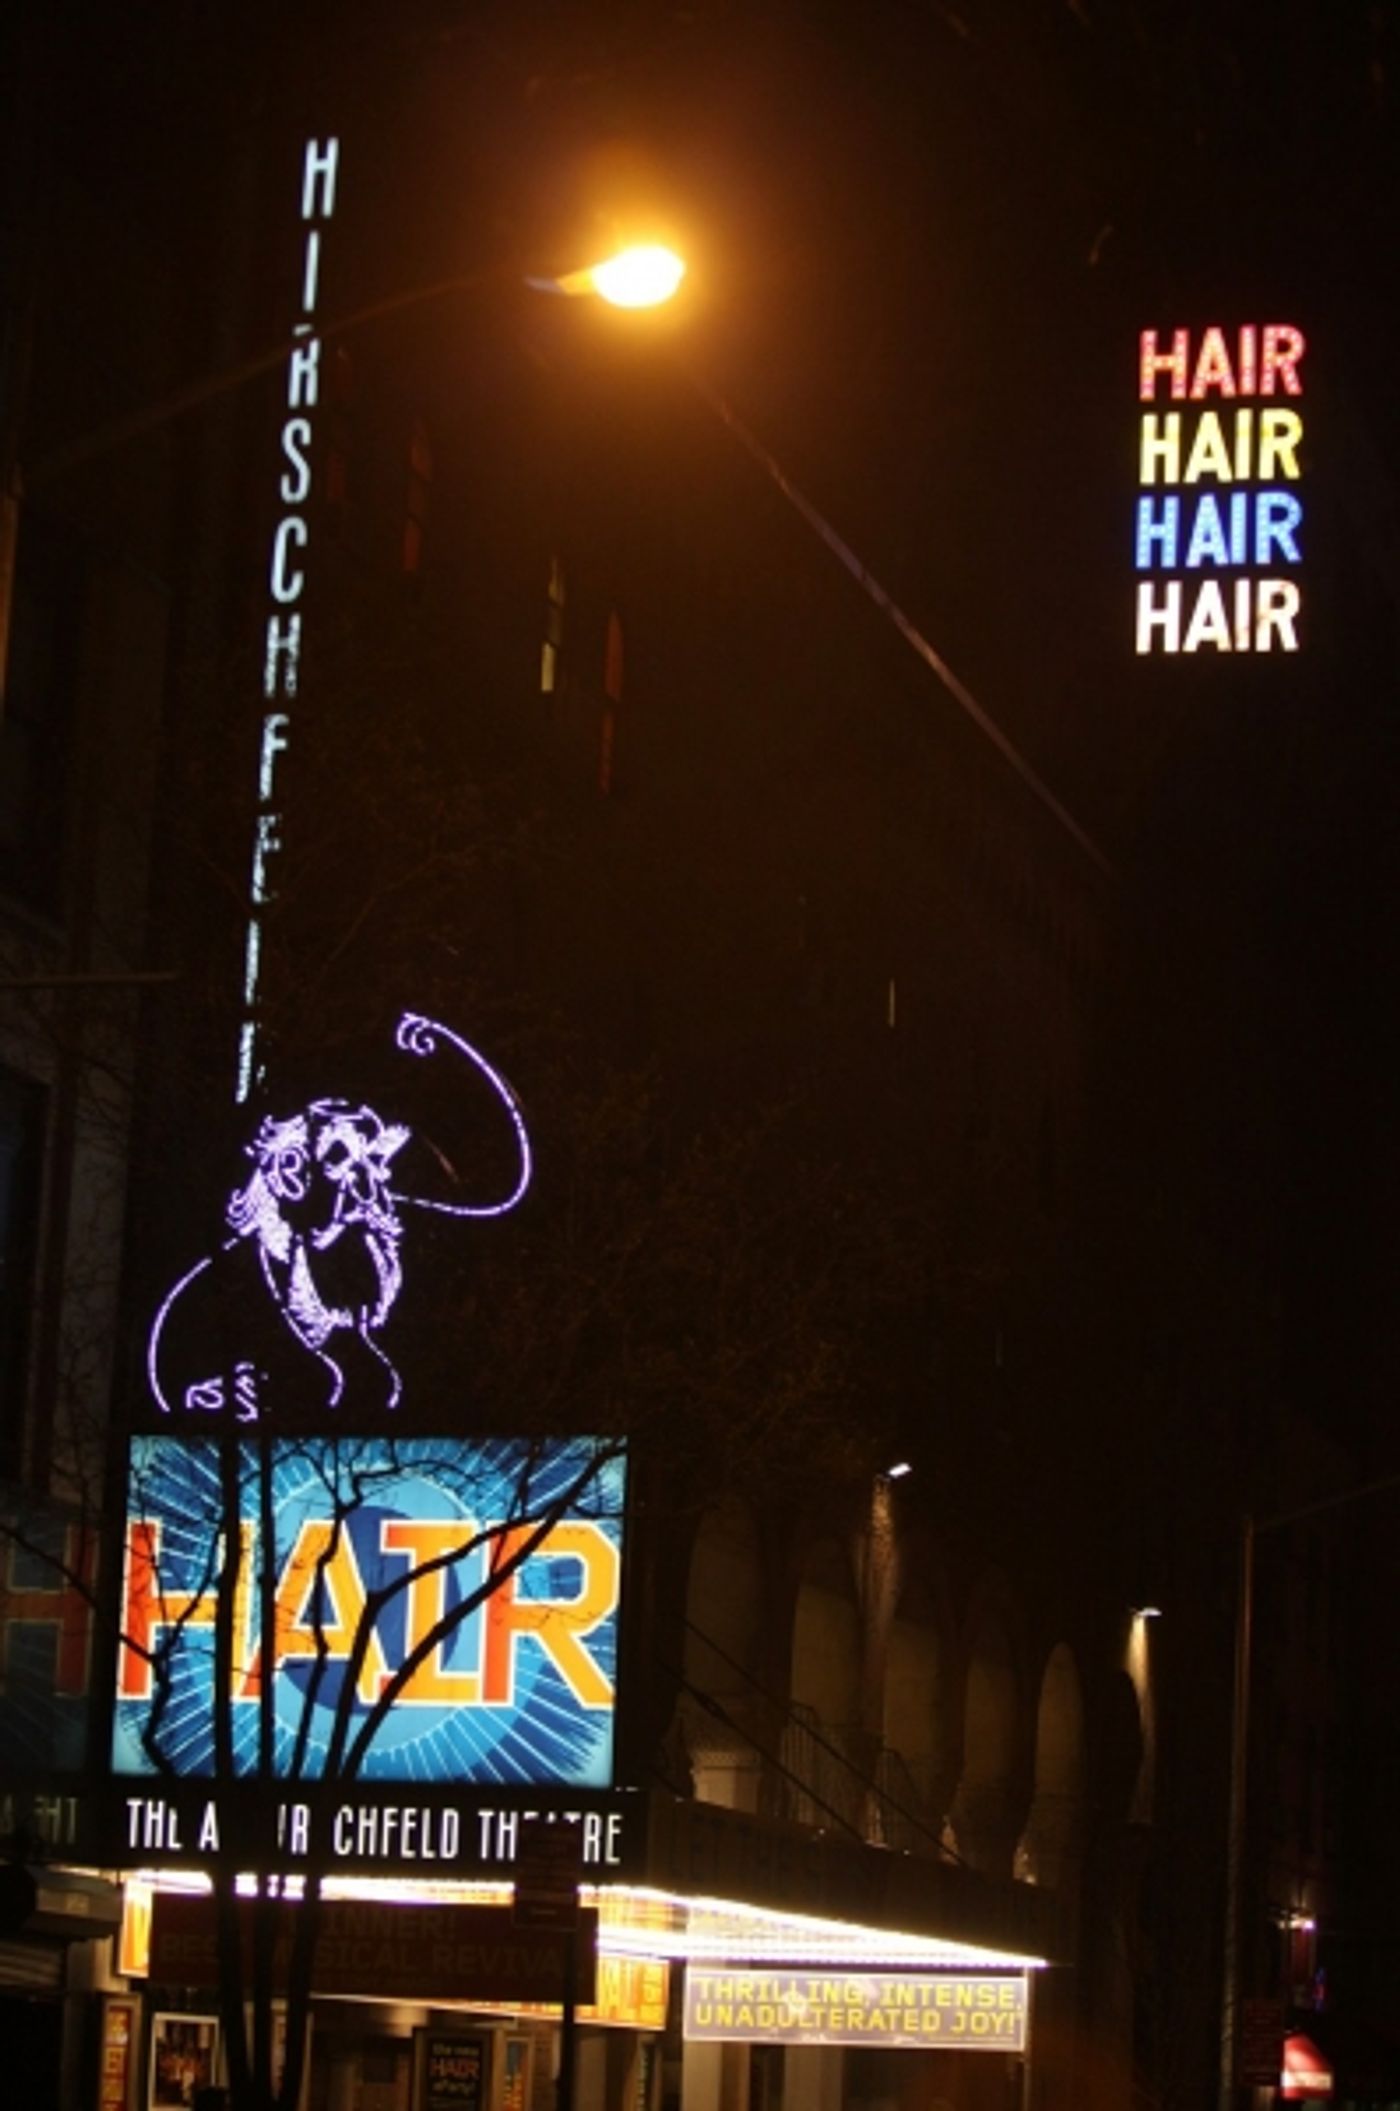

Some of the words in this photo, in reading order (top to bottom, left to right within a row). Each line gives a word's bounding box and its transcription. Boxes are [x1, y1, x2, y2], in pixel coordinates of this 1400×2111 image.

[1140, 325, 1305, 401] HAIR
[1139, 408, 1303, 484] HAIR
[1136, 492, 1302, 568] HAIR
[1136, 580, 1300, 654] HAIR
[117, 1519, 622, 1710] HAIR
[478, 1808, 624, 1865] THRE
[432, 1945, 584, 1979] REVIVA
[695, 2004, 942, 2033] UNADULTERATED
[950, 2012, 1018, 2036] JOY!
